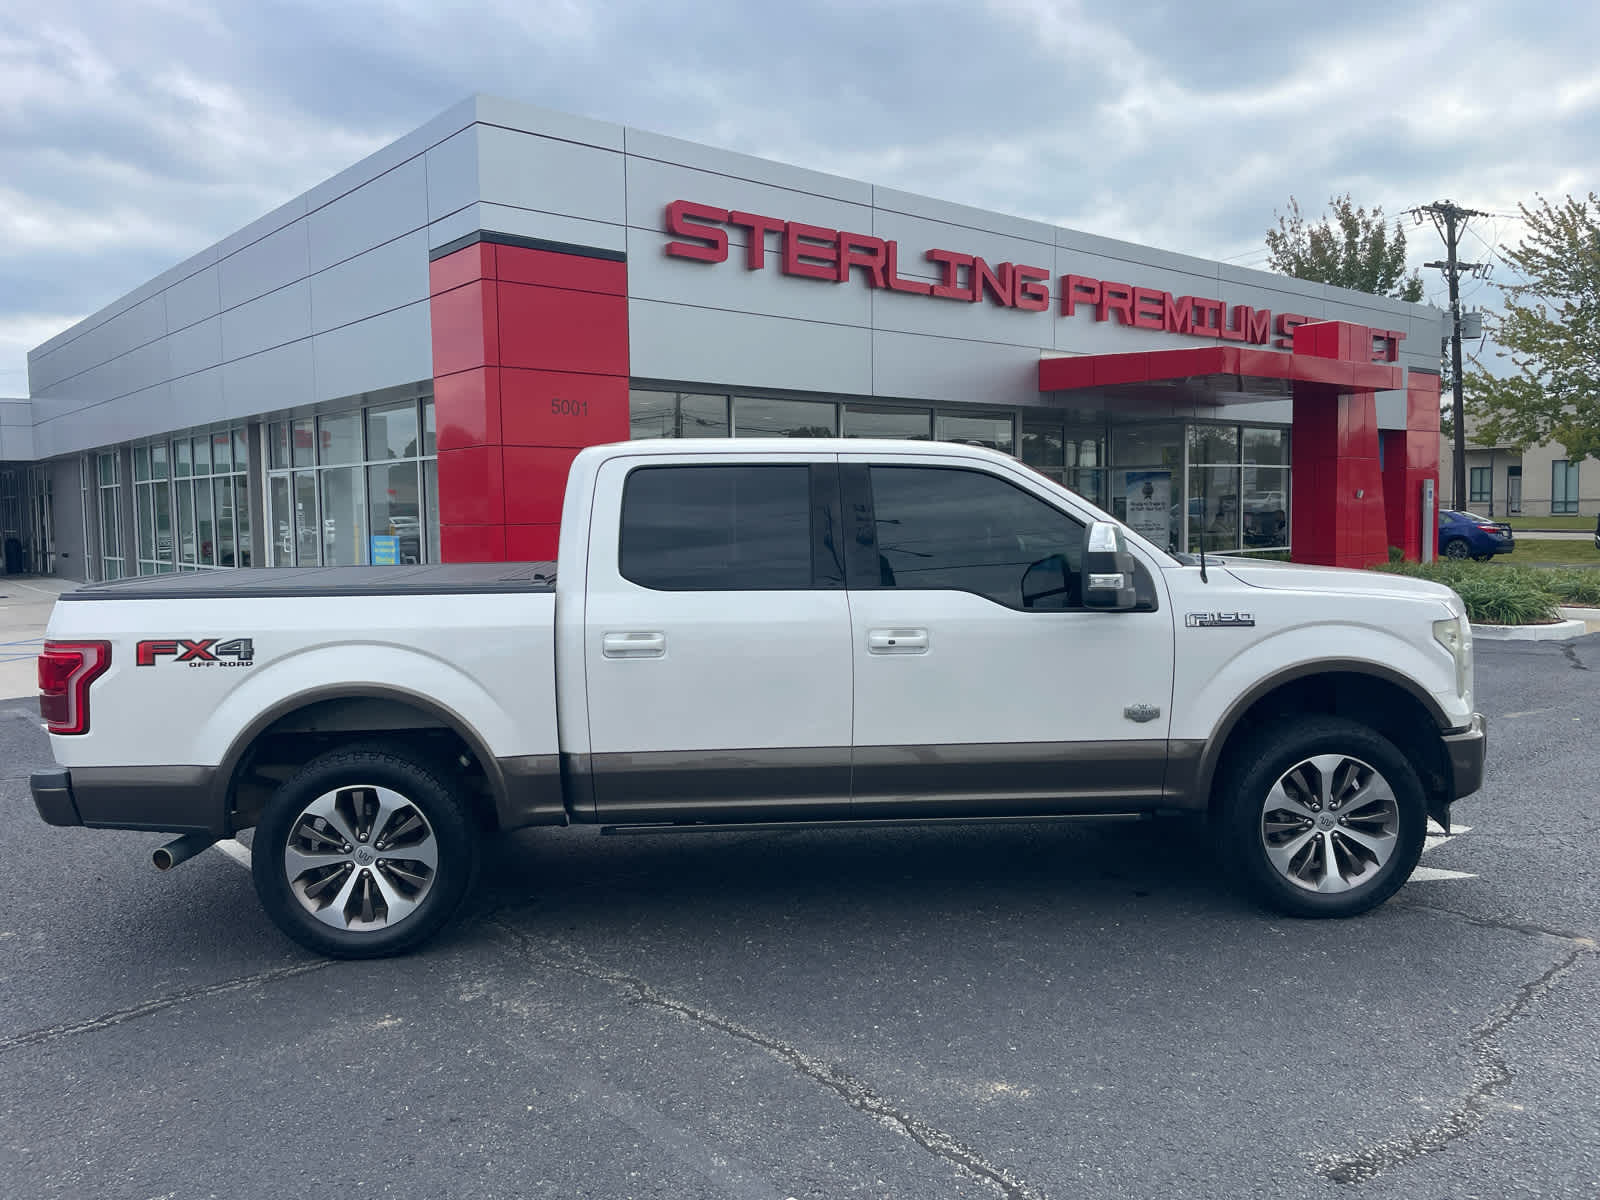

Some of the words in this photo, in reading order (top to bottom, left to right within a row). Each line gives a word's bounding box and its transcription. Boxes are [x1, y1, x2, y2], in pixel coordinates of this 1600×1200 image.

[665, 199, 1050, 312] STERLING
[1060, 274, 1272, 345] PREMIUM
[1276, 312, 1408, 363] SCT
[551, 398, 590, 417] 5001
[136, 638, 254, 667] FX4
